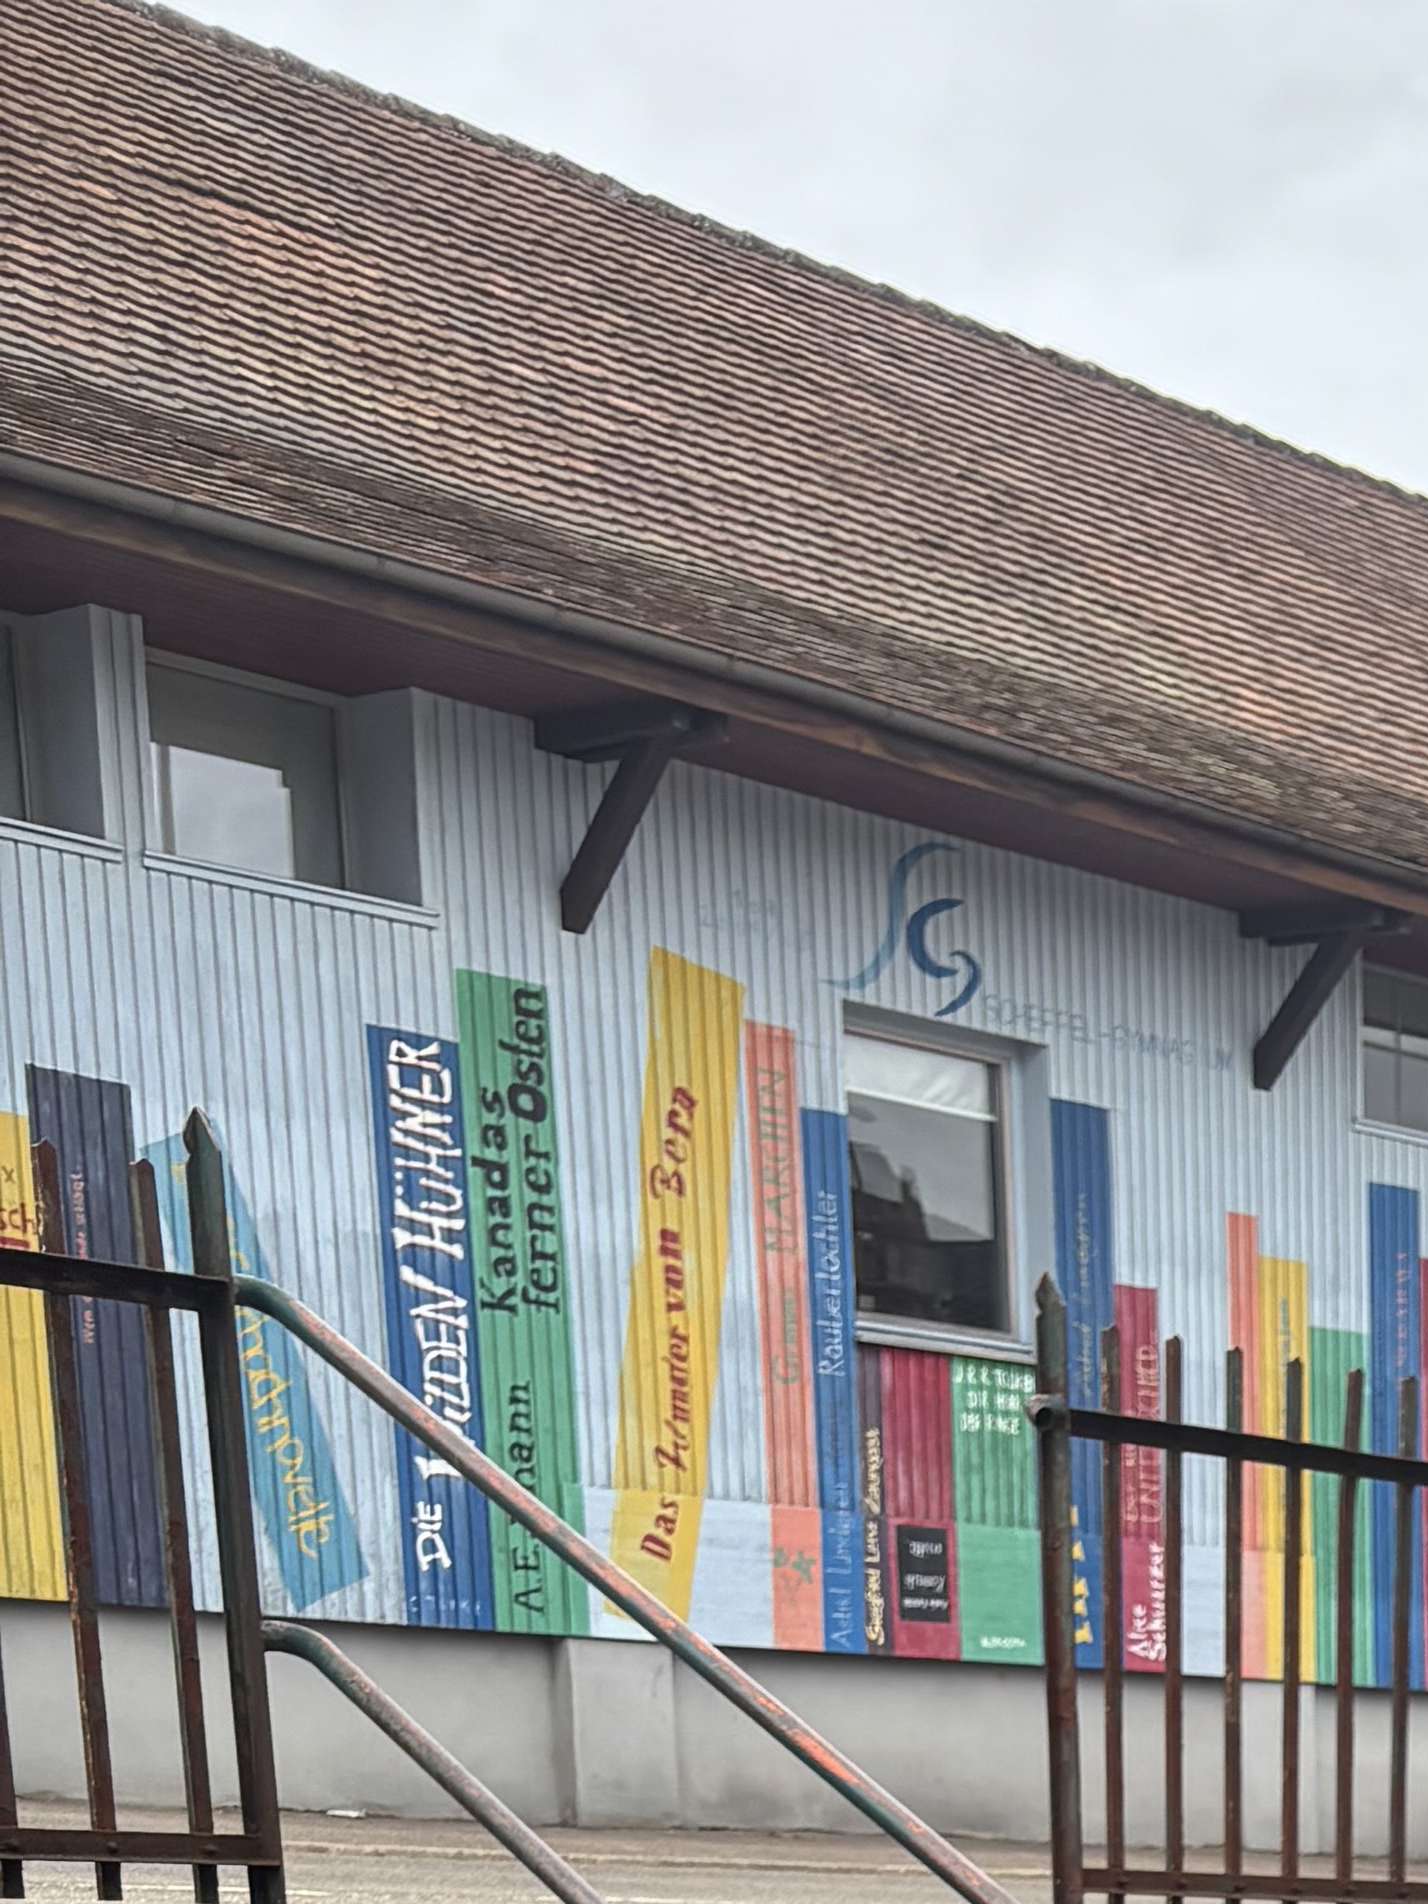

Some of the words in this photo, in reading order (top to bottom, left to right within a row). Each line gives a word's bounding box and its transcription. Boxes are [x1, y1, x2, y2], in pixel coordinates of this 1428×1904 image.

[507, 985, 550, 1124] Osten
[650, 1085, 700, 1199] Bern
[471, 1090, 519, 1316] Kanadas
[521, 1135, 560, 1314] ferner
[661, 1226, 687, 1316] von
[416, 1501, 450, 1572] DIE
[640, 1494, 680, 1564] Das
[1127, 1603, 1150, 1658] Alice
